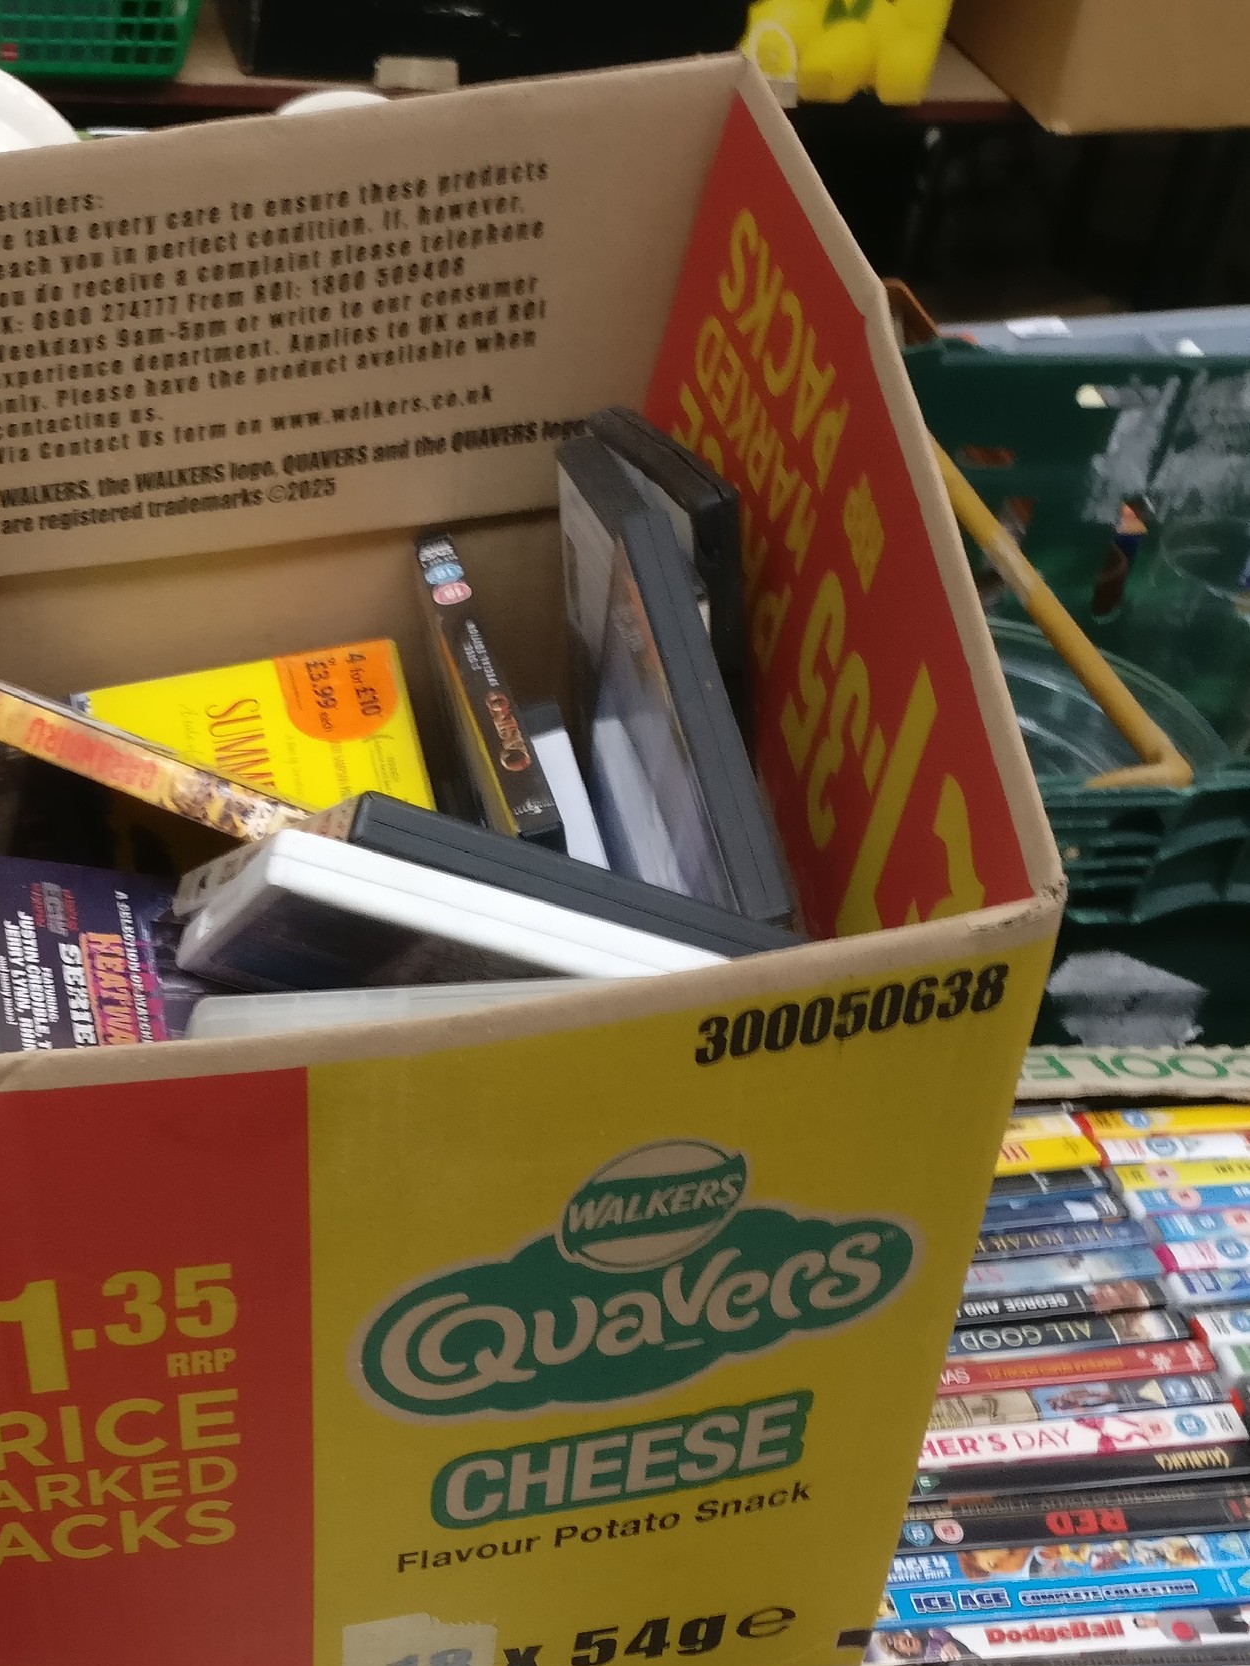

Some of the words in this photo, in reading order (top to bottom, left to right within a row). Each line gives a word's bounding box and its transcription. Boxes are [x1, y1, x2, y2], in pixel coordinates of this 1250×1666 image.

[24, 224, 78, 247] take
[88, 216, 158, 240] every
[166, 206, 220, 229] care
[230, 202, 254, 221] to
[263, 190, 349, 217] ensure
[359, 178, 427, 205] these
[438, 162, 549, 196] products
[35, 284, 63, 303] do
[72, 272, 165, 299] receive
[197, 250, 321, 284] complaint
[330, 239, 411, 269] please
[420, 220, 544, 254] telephone
[60, 252, 103, 274] you
[112, 247, 137, 265] in
[147, 231, 238, 263] perfect
[246, 217, 374, 249] condition.
[116, 319, 227, 348] 9am-5pm
[236, 315, 260, 333] or
[269, 305, 331, 328] write
[341, 301, 363, 320] to
[372, 294, 411, 315] our
[420, 277, 538, 309] consumer
[132, 338, 281, 373] department.
[457, 306, 499, 330] and
[719, 208, 849, 494] PACKS
[56, 383, 136, 408] Please
[144, 376, 200, 397] have
[208, 370, 246, 389] the
[255, 353, 348, 387] product
[356, 339, 466, 370] available
[476, 330, 536, 353] when
[174, 422, 226, 444] form
[236, 418, 262, 435] on
[694, 313, 817, 576] MARKED
[98, 477, 131, 496] the
[135, 463, 225, 493] WALKERS
[1, 517, 34, 535] are
[39, 501, 143, 531] registered
[147, 489, 263, 518] trademarks
[347, 652, 367, 665] 4
[353, 668, 365, 687] for
[306, 661, 337, 710] £3.99
[3, 919, 26, 967] JERRY
[17, 910, 40, 963] JUSTIN
[116, 901, 141, 973] SELECTION
[10, 969, 31, 1013] LYNN,
[58, 942, 98, 1048] SERIE
[694, 962, 1010, 1066] 300050638
[569, 1173, 743, 1233] WALKERS
[964, 1300, 1002, 1317] AND
[1006, 1293, 1068, 1313] GEORGE
[960, 1325, 1041, 1350] GOOD
[1047, 1318, 1091, 1341] ALL
[166, 1348, 237, 1378] RRP
[445, 1398, 797, 1521] CHEESE
[1014, 1427, 1075, 1451] DAY
[396, 1535, 541, 1574] Flavour
[554, 1511, 680, 1548] Potato
[695, 1482, 812, 1524] Snack
[1046, 1508, 1128, 1536] RED
[894, 1558, 931, 1572] AGE
[912, 1592, 955, 1614] ICE
[958, 1588, 1010, 1610] AGE
[1019, 1586, 1102, 1606] COMPLETE
[1103, 1579, 1198, 1600] COLLECTION
[985, 1619, 1125, 1646] DodgeBall
